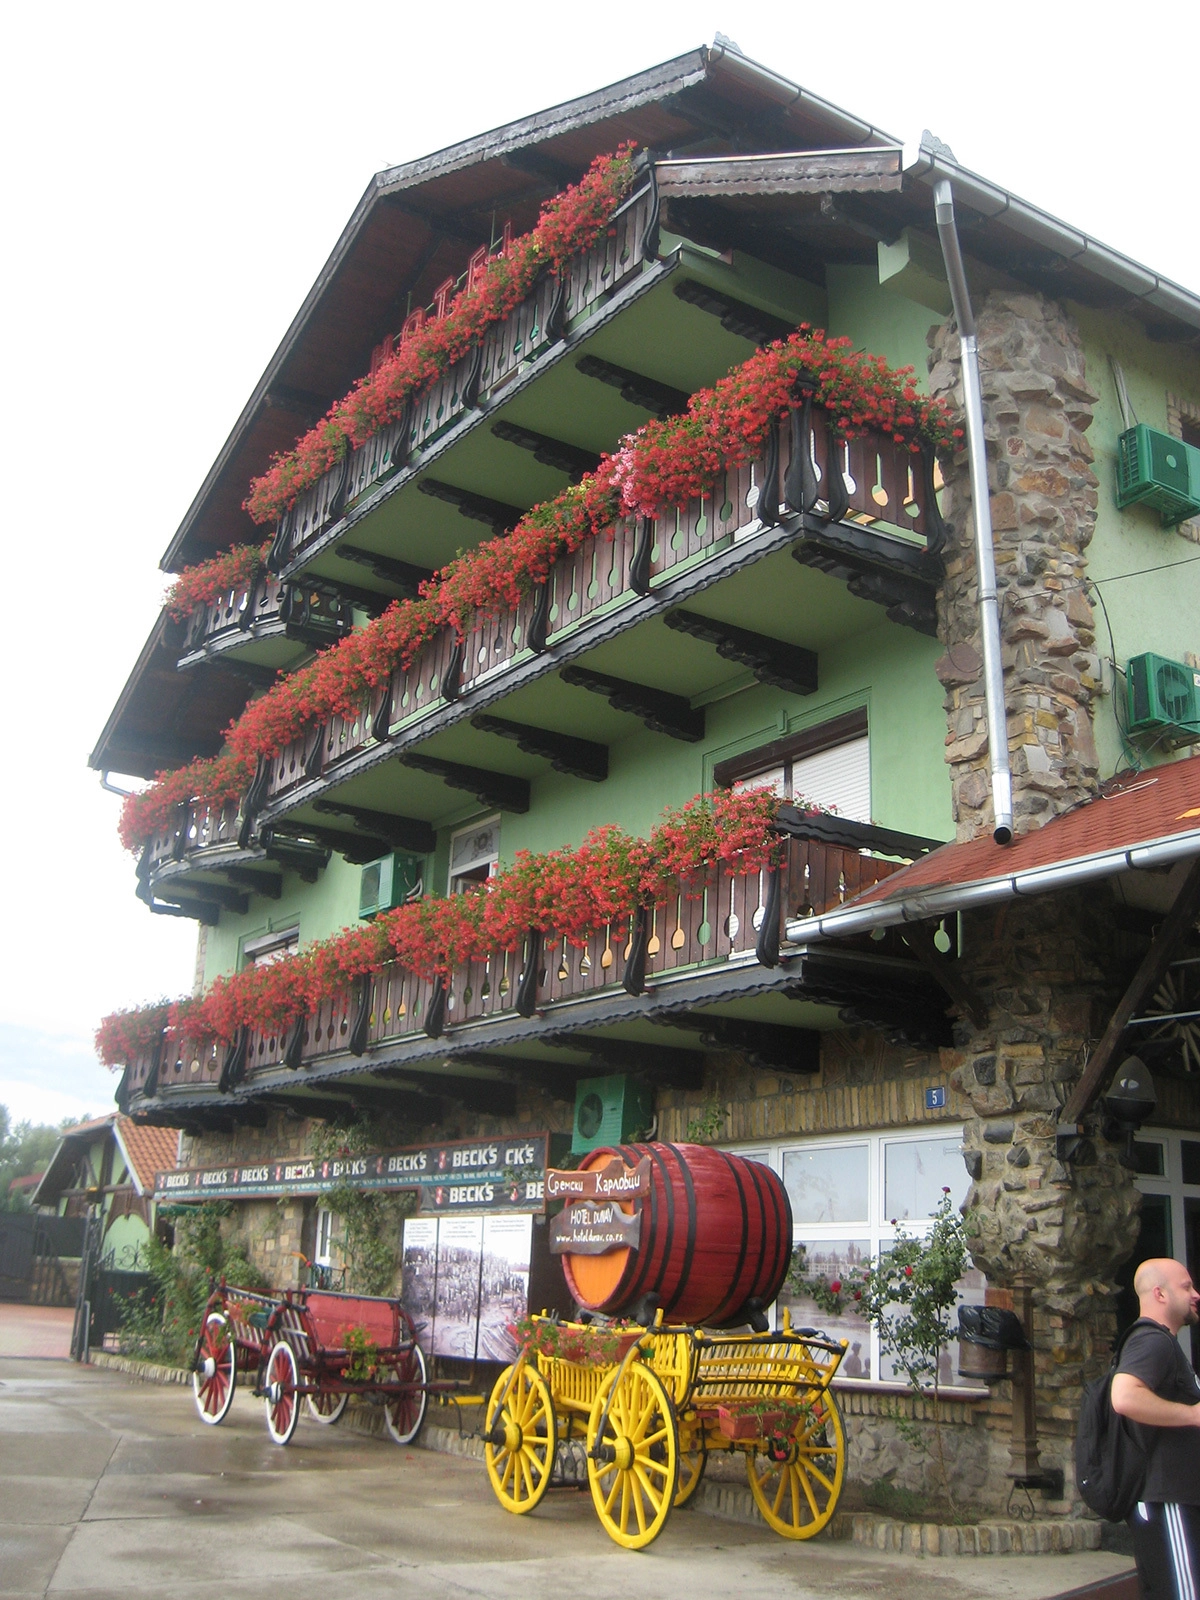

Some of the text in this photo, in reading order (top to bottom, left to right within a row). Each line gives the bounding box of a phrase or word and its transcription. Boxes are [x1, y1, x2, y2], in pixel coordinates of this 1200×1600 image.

[932, 1090, 938, 1105] 5
[166, 1172, 190, 1188] BECK'S
[202, 1169, 228, 1185] BECK'S
[240, 1165, 269, 1183] BECK'S
[388, 1151, 427, 1172] BECK'S
[452, 1145, 498, 1168] BECK'S
[505, 1144, 535, 1165] CK'S
[449, 1182, 494, 1203] BECK'S
[547, 1172, 640, 1196] Сремски Карловци
[570, 1207, 614, 1225] HOTEL DUNAV
[555, 1228, 624, 1243] www.hoteldunav.co.rs
